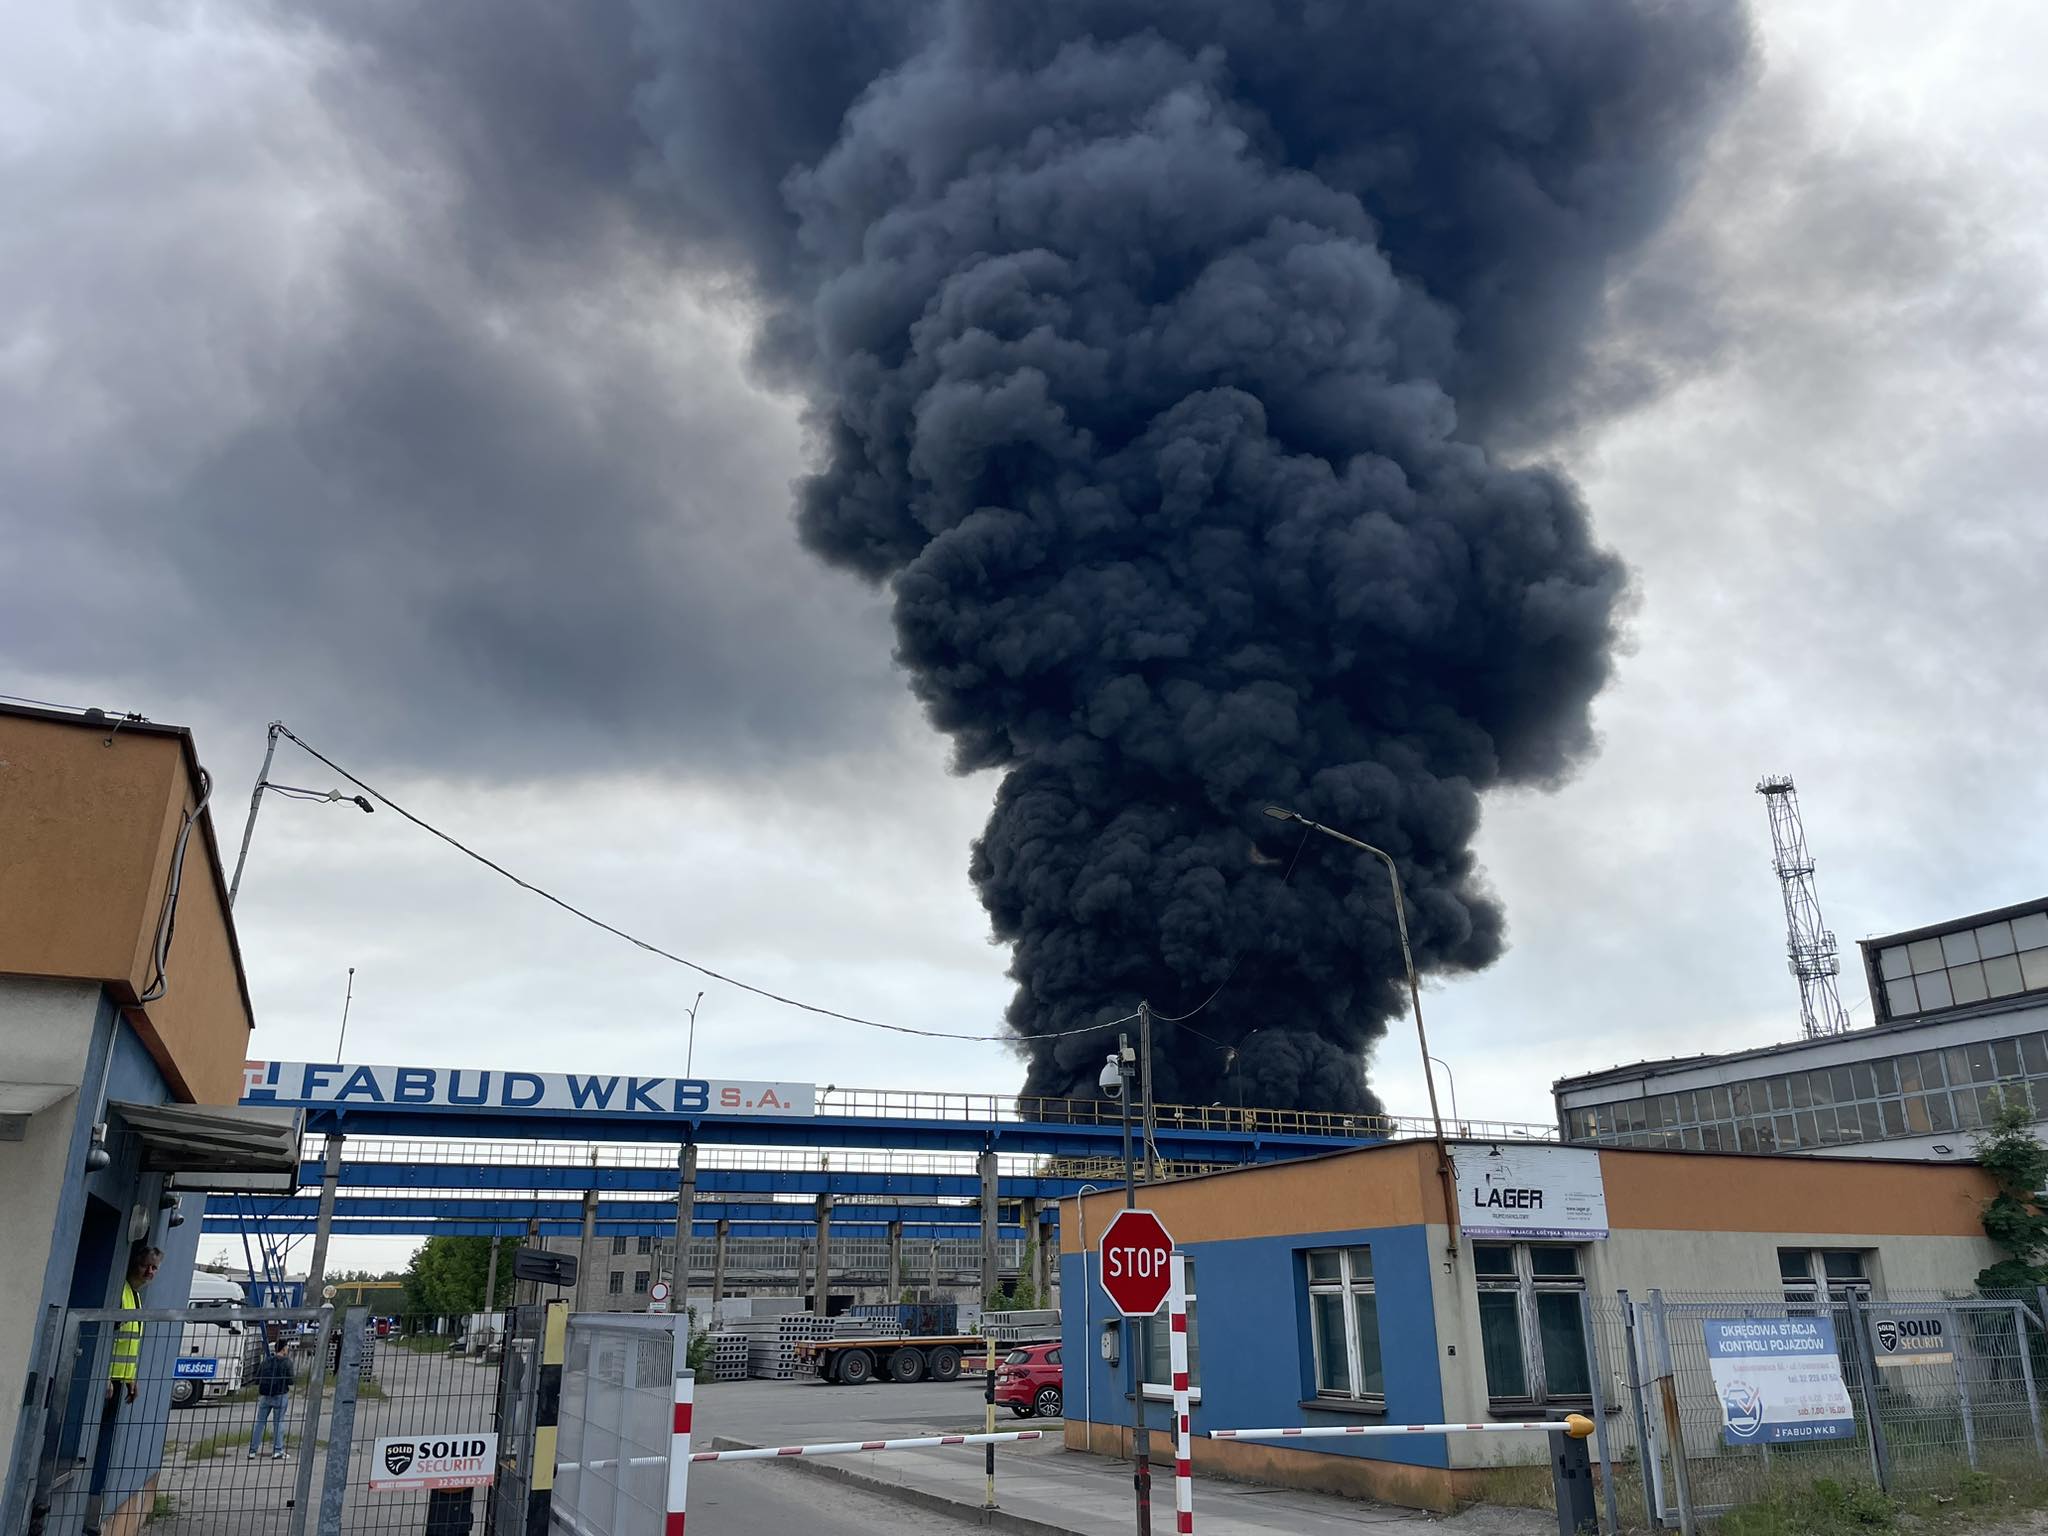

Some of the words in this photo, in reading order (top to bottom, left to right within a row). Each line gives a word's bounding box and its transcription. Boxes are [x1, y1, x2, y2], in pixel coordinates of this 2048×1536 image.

[300, 1063, 545, 1107] FABUD
[566, 1074, 710, 1112] WKB
[720, 1087, 791, 1108] S.A.
[1474, 1187, 1543, 1209] LAGER
[1109, 1247, 1167, 1278] STOP
[1721, 1324, 1778, 1338] OKRĘGOWA
[1779, 1323, 1817, 1335] STACJA
[1898, 1319, 1942, 1337] SOLID
[1719, 1340, 1768, 1352] KONTROLI
[1769, 1337, 1824, 1351] POJAZDÓW
[1901, 1336, 1944, 1350] SECURITY
[177, 1361, 214, 1373] WEJŚCIE
[1782, 1427, 1812, 1437] FABUD
[1814, 1426, 1836, 1434] WKB
[387, 1445, 413, 1455] SOLID
[418, 1440, 486, 1459] SOLID
[416, 1457, 485, 1473] SECURITY
